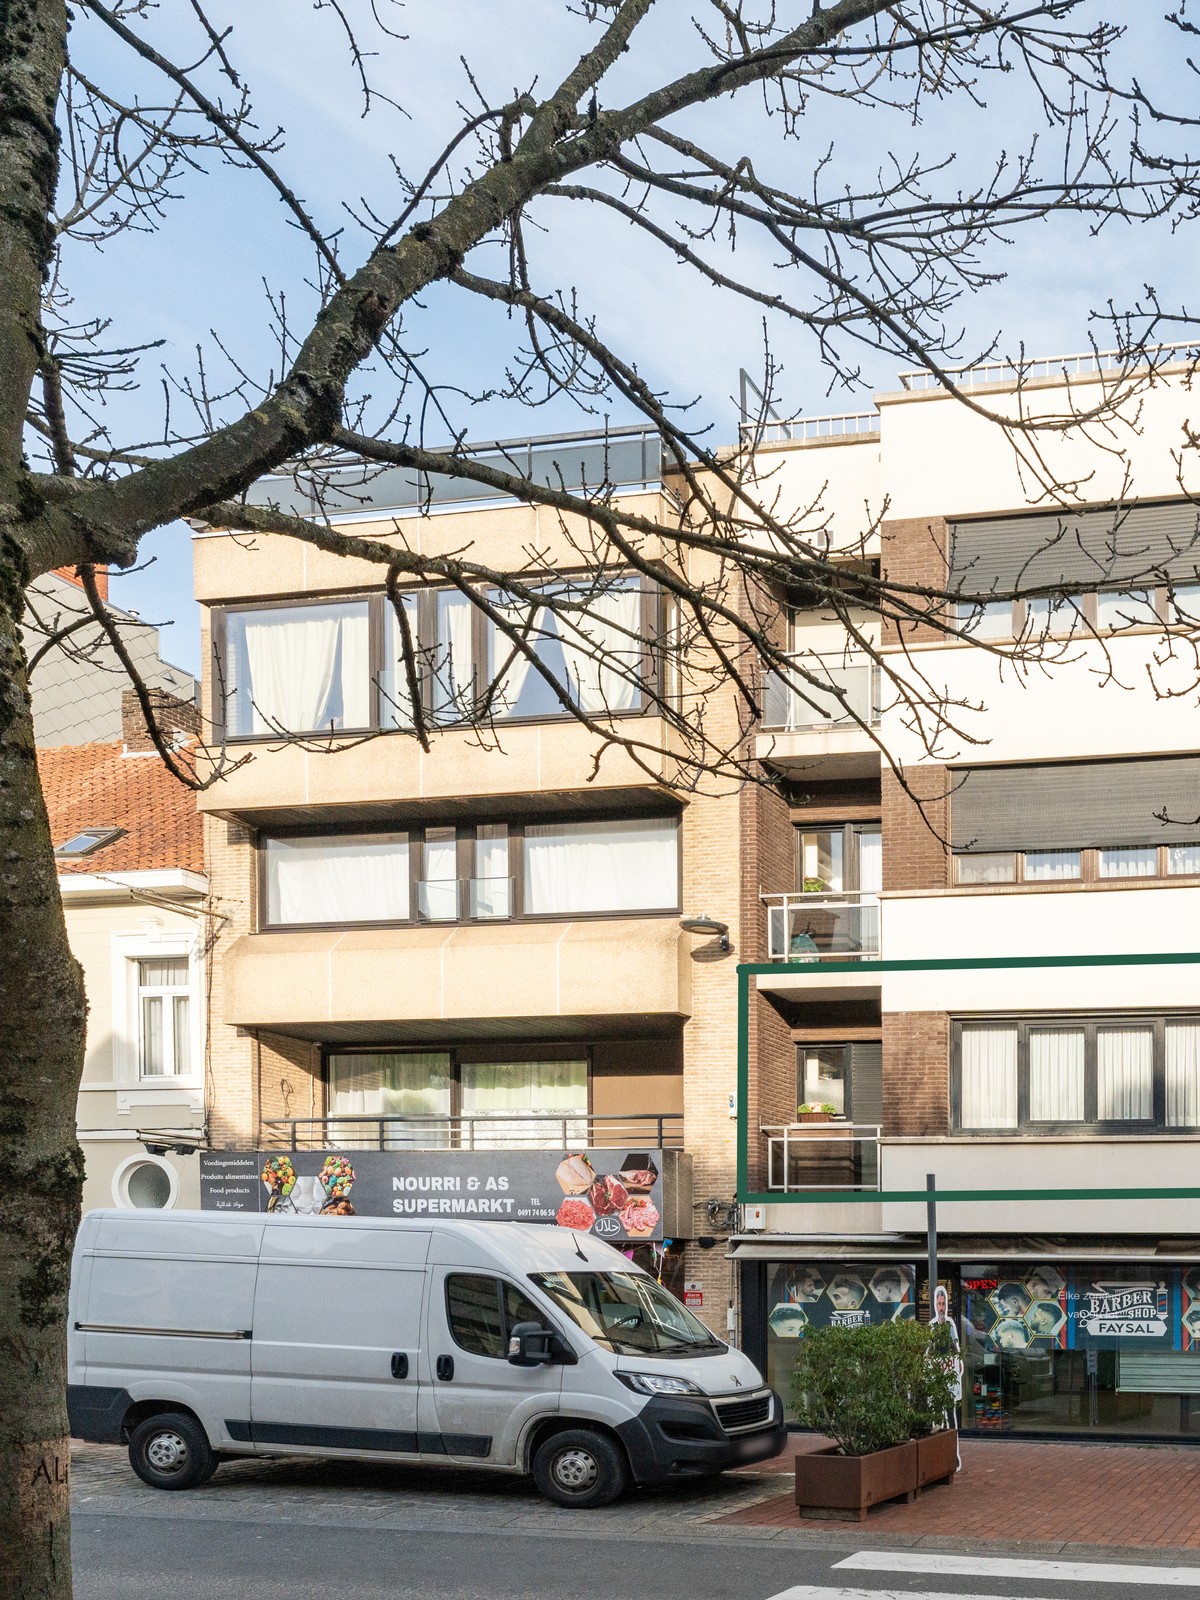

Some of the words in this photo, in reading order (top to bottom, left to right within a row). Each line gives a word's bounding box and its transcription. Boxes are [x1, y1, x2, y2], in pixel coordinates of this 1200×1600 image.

[203, 1159, 255, 1168] Voedingsmiddelen
[392, 1176, 461, 1191] NOURRI
[467, 1176, 481, 1191] &
[485, 1176, 509, 1191] AS
[225, 1187, 250, 1195] products
[392, 1198, 515, 1213] SUPERMARKT
[530, 1198, 541, 1206] TEL
[517, 1208, 531, 1216] 0491
[532, 1208, 540, 1216] 74
[540, 1208, 547, 1216] 06
[548, 1208, 556, 1217] 56
[596, 1219, 620, 1232] حلال
[964, 1279, 997, 1290] OPEN
[1089, 1290, 1153, 1314] BARBER
[1127, 1307, 1158, 1319] SHOP
[831, 1315, 863, 1327] BARBER
[1098, 1323, 1155, 1334] FAYSAL
